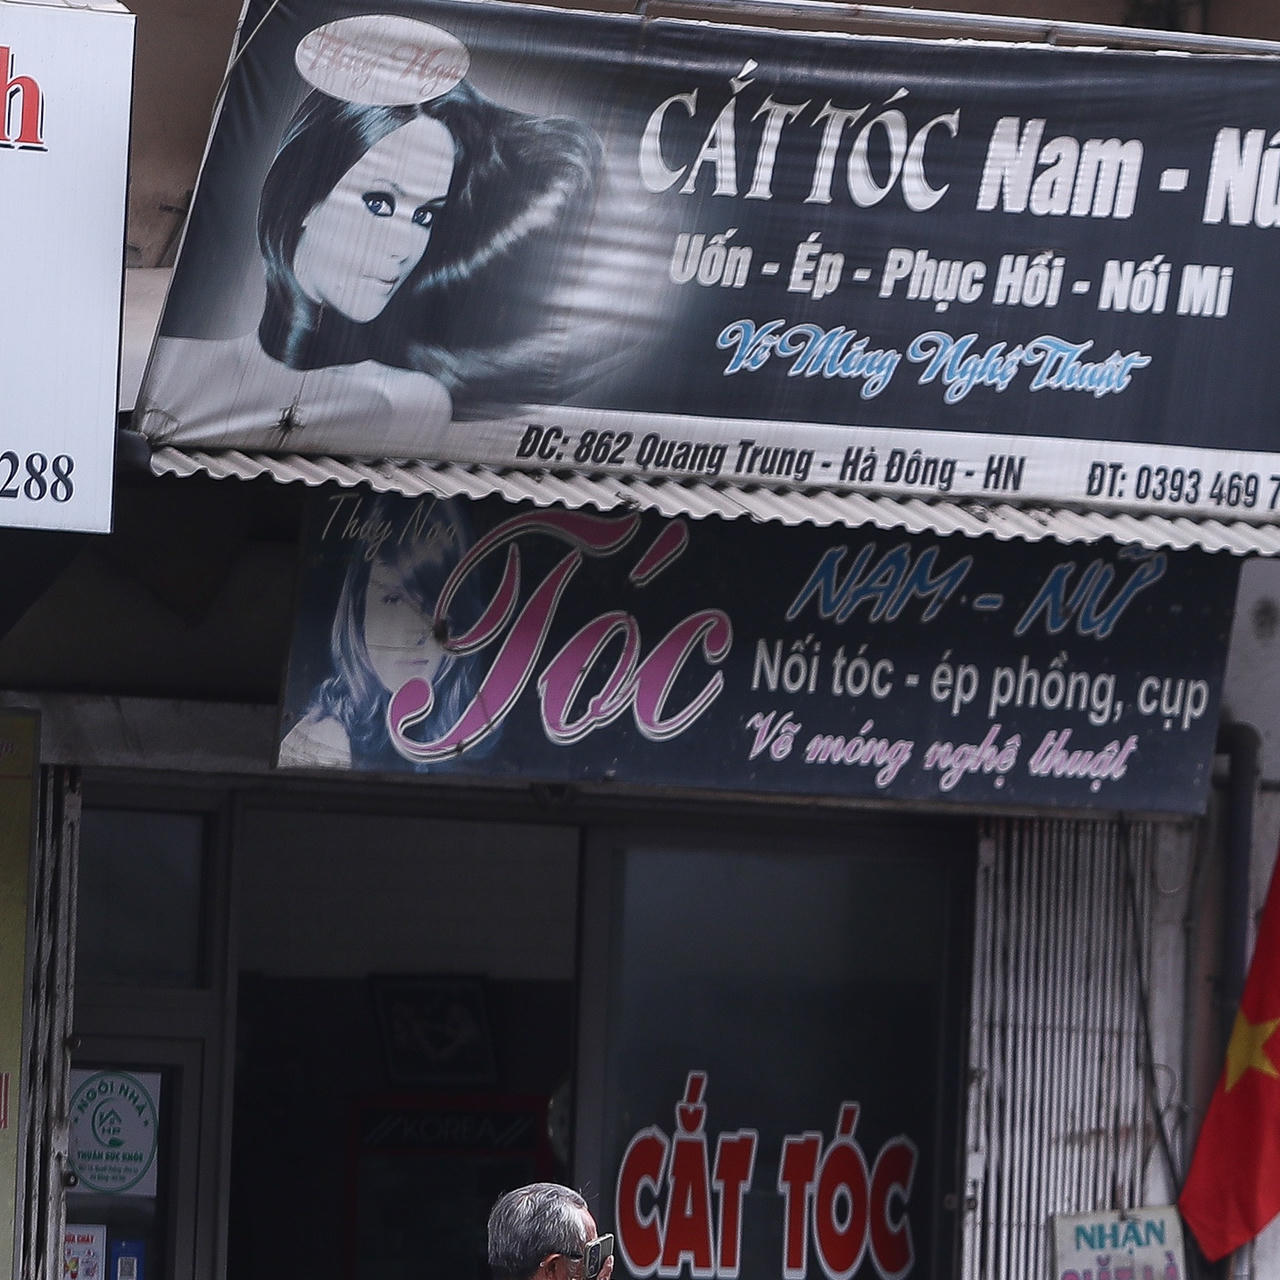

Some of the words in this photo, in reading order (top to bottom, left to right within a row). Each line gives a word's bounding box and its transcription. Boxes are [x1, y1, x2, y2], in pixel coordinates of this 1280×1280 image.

[638, 58, 812, 199] CẮT
[803, 86, 961, 212] TÓC
[976, 116, 1144, 219] Nam
[670, 228, 753, 288] Uốn
[787, 231, 845, 299] Ép
[878, 248, 986, 313] Phục
[1098, 254, 1172, 315] Nối
[1176, 264, 1234, 318] Mi
[715, 318, 786, 376] Vẽ
[1022, 334, 1152, 399] Thuật
[0, 450, 76, 503] 288
[515, 423, 566, 460] ĐC:
[573, 428, 635, 466] 862
[635, 431, 729, 475] Quang
[735, 438, 816, 482] Trung
[839, 444, 877, 484] Hà
[884, 446, 958, 493] Đông
[982, 455, 1026, 492] HN
[1085, 459, 1128, 498] ĐT:
[1134, 464, 1200, 505] 0393
[1208, 470, 1262, 508] 469
[386, 508, 735, 764] Tóc
[786, 543, 974, 623] NAM
[1013, 546, 1167, 639] NỮ
[751, 632, 820, 694] Nối
[831, 642, 895, 698] tóc
[930, 648, 980, 715] ép
[1137, 679, 1210, 729] cụp
[745, 710, 802, 761] Vẽ
[805, 720, 914, 788] móng
[923, 724, 1020, 791] nghệ
[1027, 727, 1139, 792] thuật
[616, 1070, 758, 1280] CẮT
